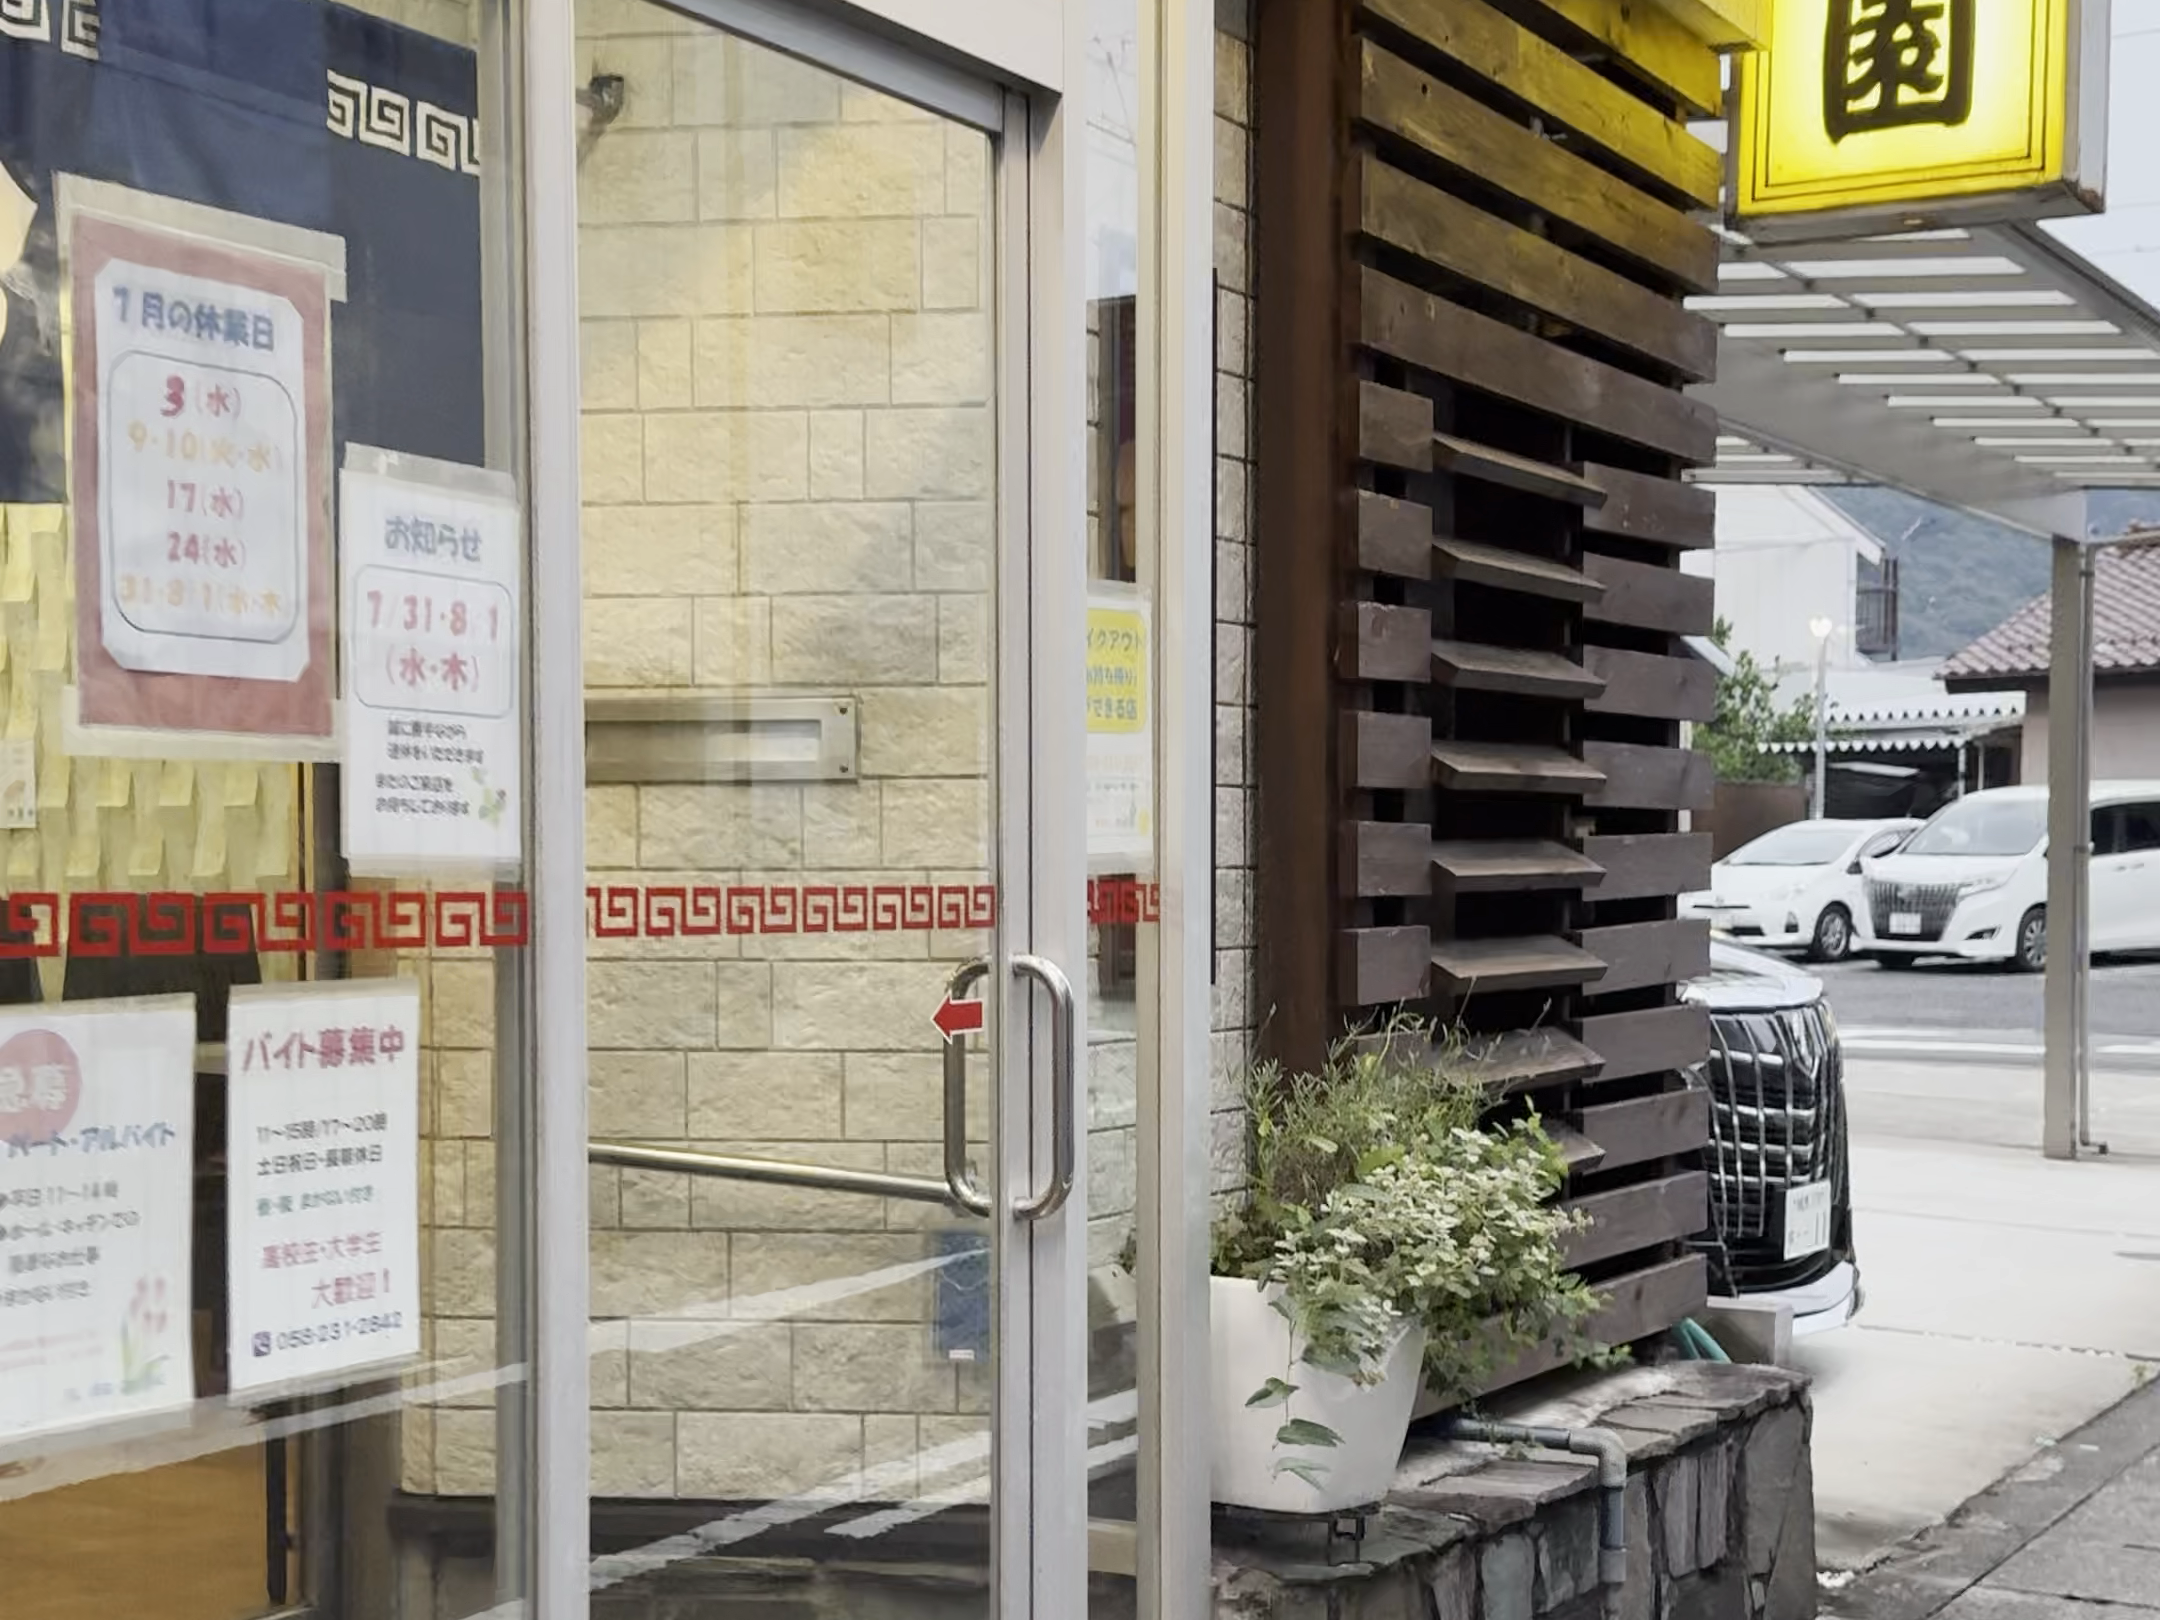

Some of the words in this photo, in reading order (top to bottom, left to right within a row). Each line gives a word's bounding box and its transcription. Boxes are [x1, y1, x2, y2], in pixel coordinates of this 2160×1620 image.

[112, 286, 274, 352] 7月の休業日
[384, 515, 482, 562] お知らせ
[243, 1024, 404, 1073] バイト募集中
